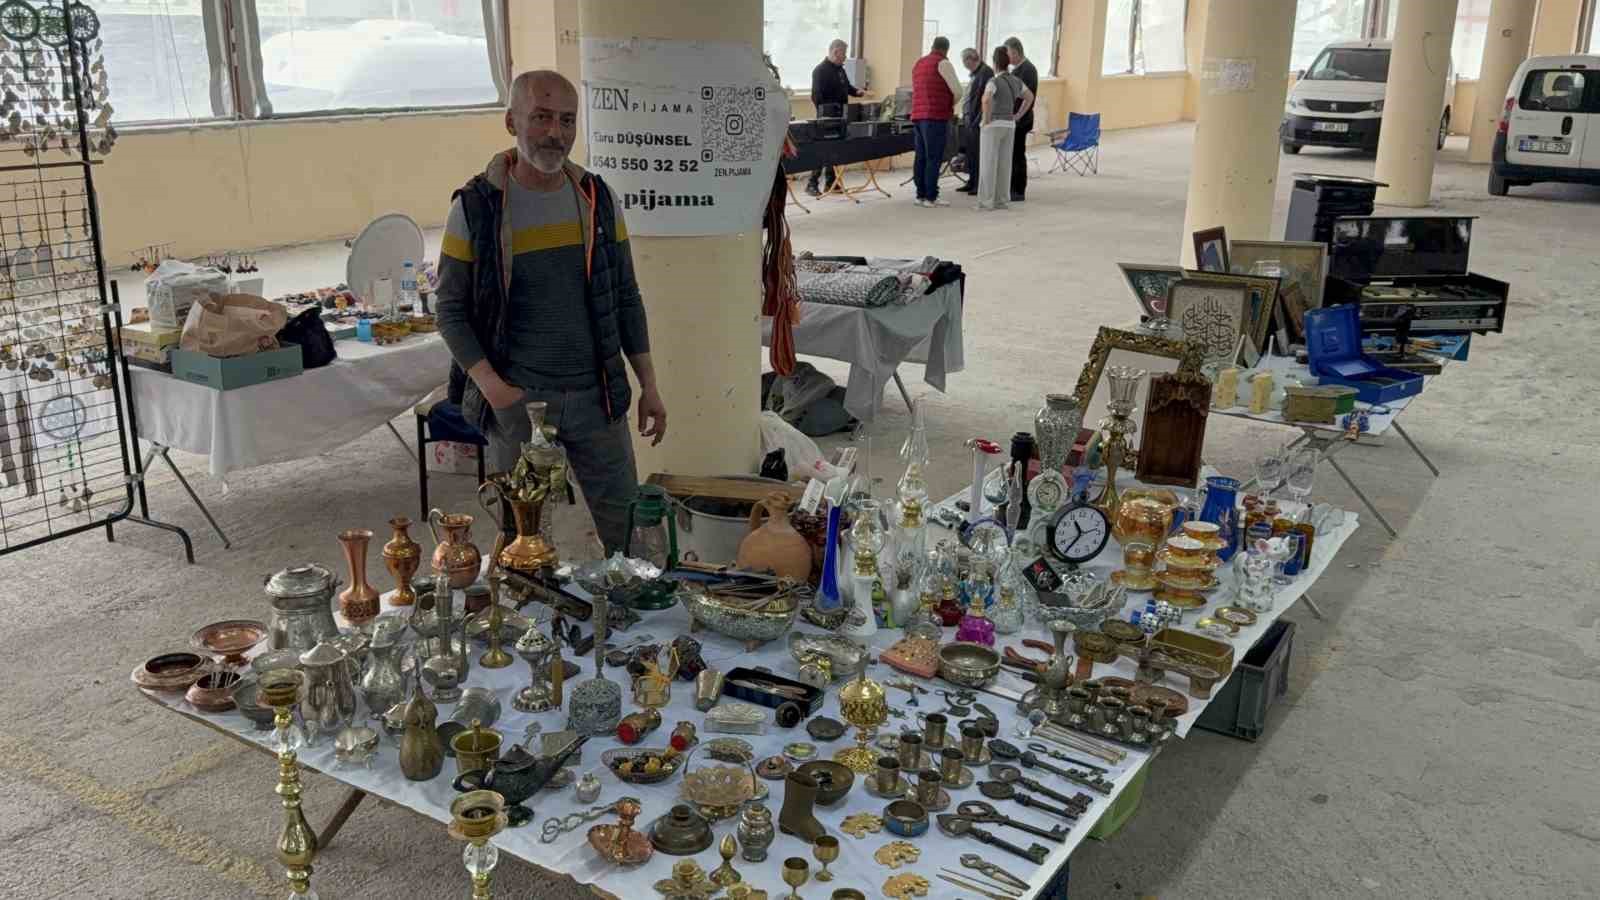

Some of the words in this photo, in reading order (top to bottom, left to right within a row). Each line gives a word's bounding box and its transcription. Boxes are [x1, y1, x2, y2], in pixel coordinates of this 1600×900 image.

[592, 87, 629, 111] ZEN
[616, 131, 693, 147] DÜŞÜNSEL
[592, 156, 617, 169] 0543
[621, 158, 648, 171] 550
[653, 159, 673, 172] 32
[679, 159, 699, 172] 52
